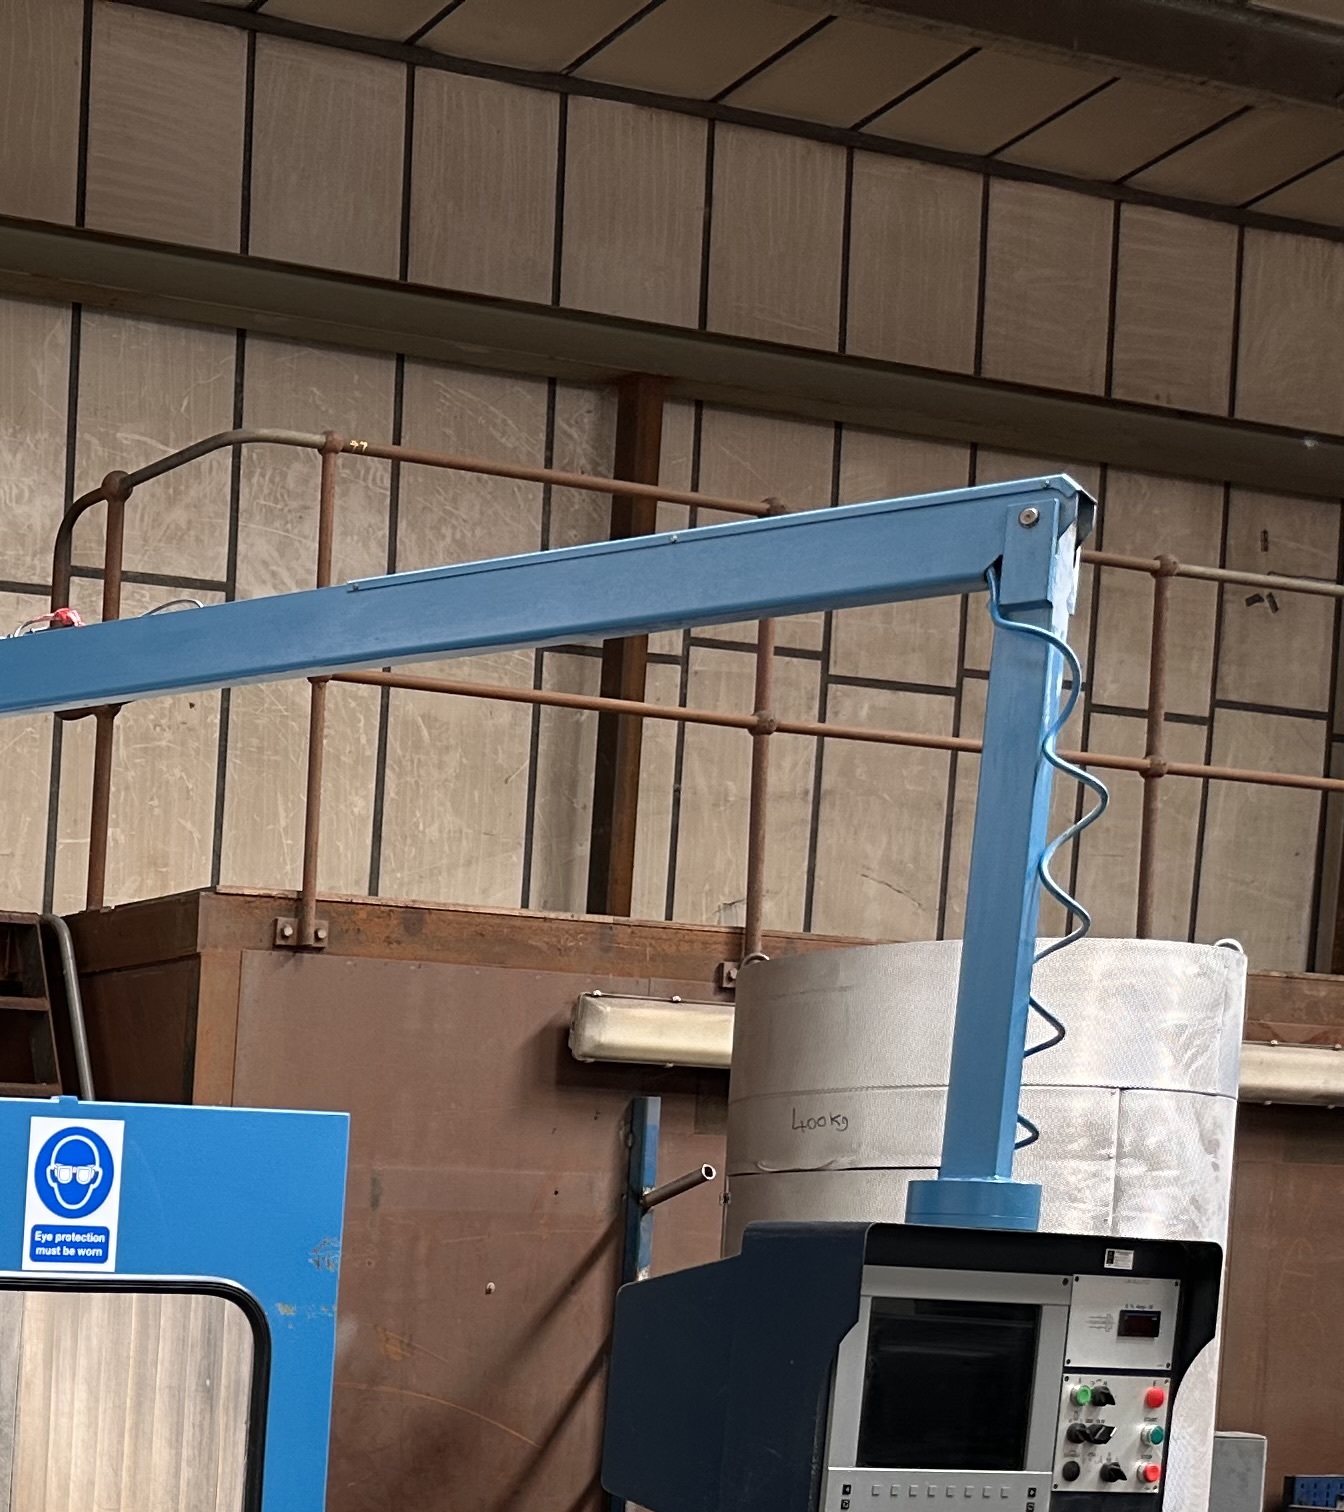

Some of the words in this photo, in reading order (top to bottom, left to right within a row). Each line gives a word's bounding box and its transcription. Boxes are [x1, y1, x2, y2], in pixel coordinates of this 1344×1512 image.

[34, 1230, 53, 1244] Eye
[55, 1231, 106, 1244] protection
[35, 1245, 61, 1256] must
[62, 1245, 76, 1256] be
[77, 1247, 103, 1257] worn
